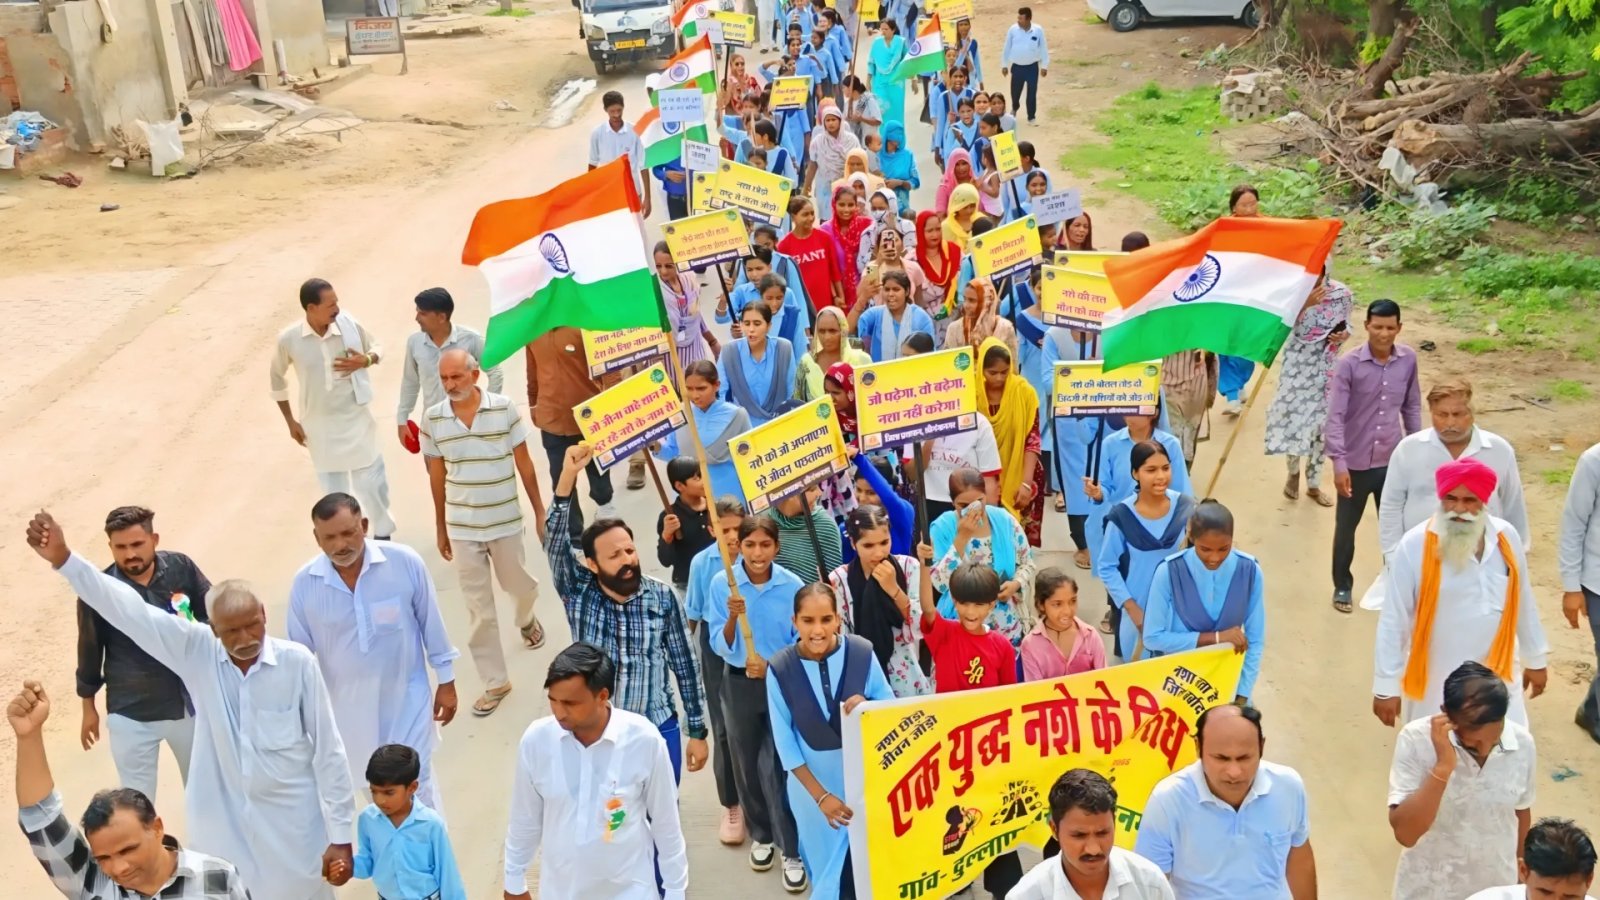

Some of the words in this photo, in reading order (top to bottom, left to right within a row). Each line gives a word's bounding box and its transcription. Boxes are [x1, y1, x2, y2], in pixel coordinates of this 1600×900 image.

[1056, 302, 1072, 312] मौत
[1075, 306, 1086, 315] को
[1062, 288, 1075, 298] नशे
[1078, 290, 1089, 301] की
[1092, 294, 1106, 304] लत
[594, 350, 606, 359] देश
[607, 345, 616, 354] के
[617, 342, 631, 352] लिए
[633, 337, 647, 346] नाम
[868, 391, 882, 406] जो
[919, 381, 931, 394] वो
[588, 420, 600, 435] जो
[603, 411, 623, 427] जीना
[624, 400, 641, 415] चाहे
[642, 391, 659, 405] शान
[660, 384, 669, 395] से
[878, 412, 900, 424] नशा
[903, 404, 922, 419] नहीं
[925, 399, 960, 415] करेगा!
[607, 431, 618, 443] रहे
[618, 422, 634, 435] नशे
[635, 417, 646, 428] के
[647, 408, 664, 420] नाम
[749, 454, 763, 469] नशे
[764, 447, 778, 462] को
[778, 442, 790, 456] जो
[790, 425, 829, 450] अपनाएगा
[755, 475, 768, 490] पूरे
[768, 464, 792, 483] जीवन
[794, 444, 833, 468] पछतायेगा
[1173, 665, 1198, 685] नशा
[874, 728, 899, 752] नशा
[878, 737, 911, 770] जीवन
[909, 715, 938, 740] जोड़ो
[887, 741, 942, 838] एक
[947, 708, 1013, 797] युद्ध
[1021, 682, 1081, 757] नशे
[1086, 680, 1123, 755] के
